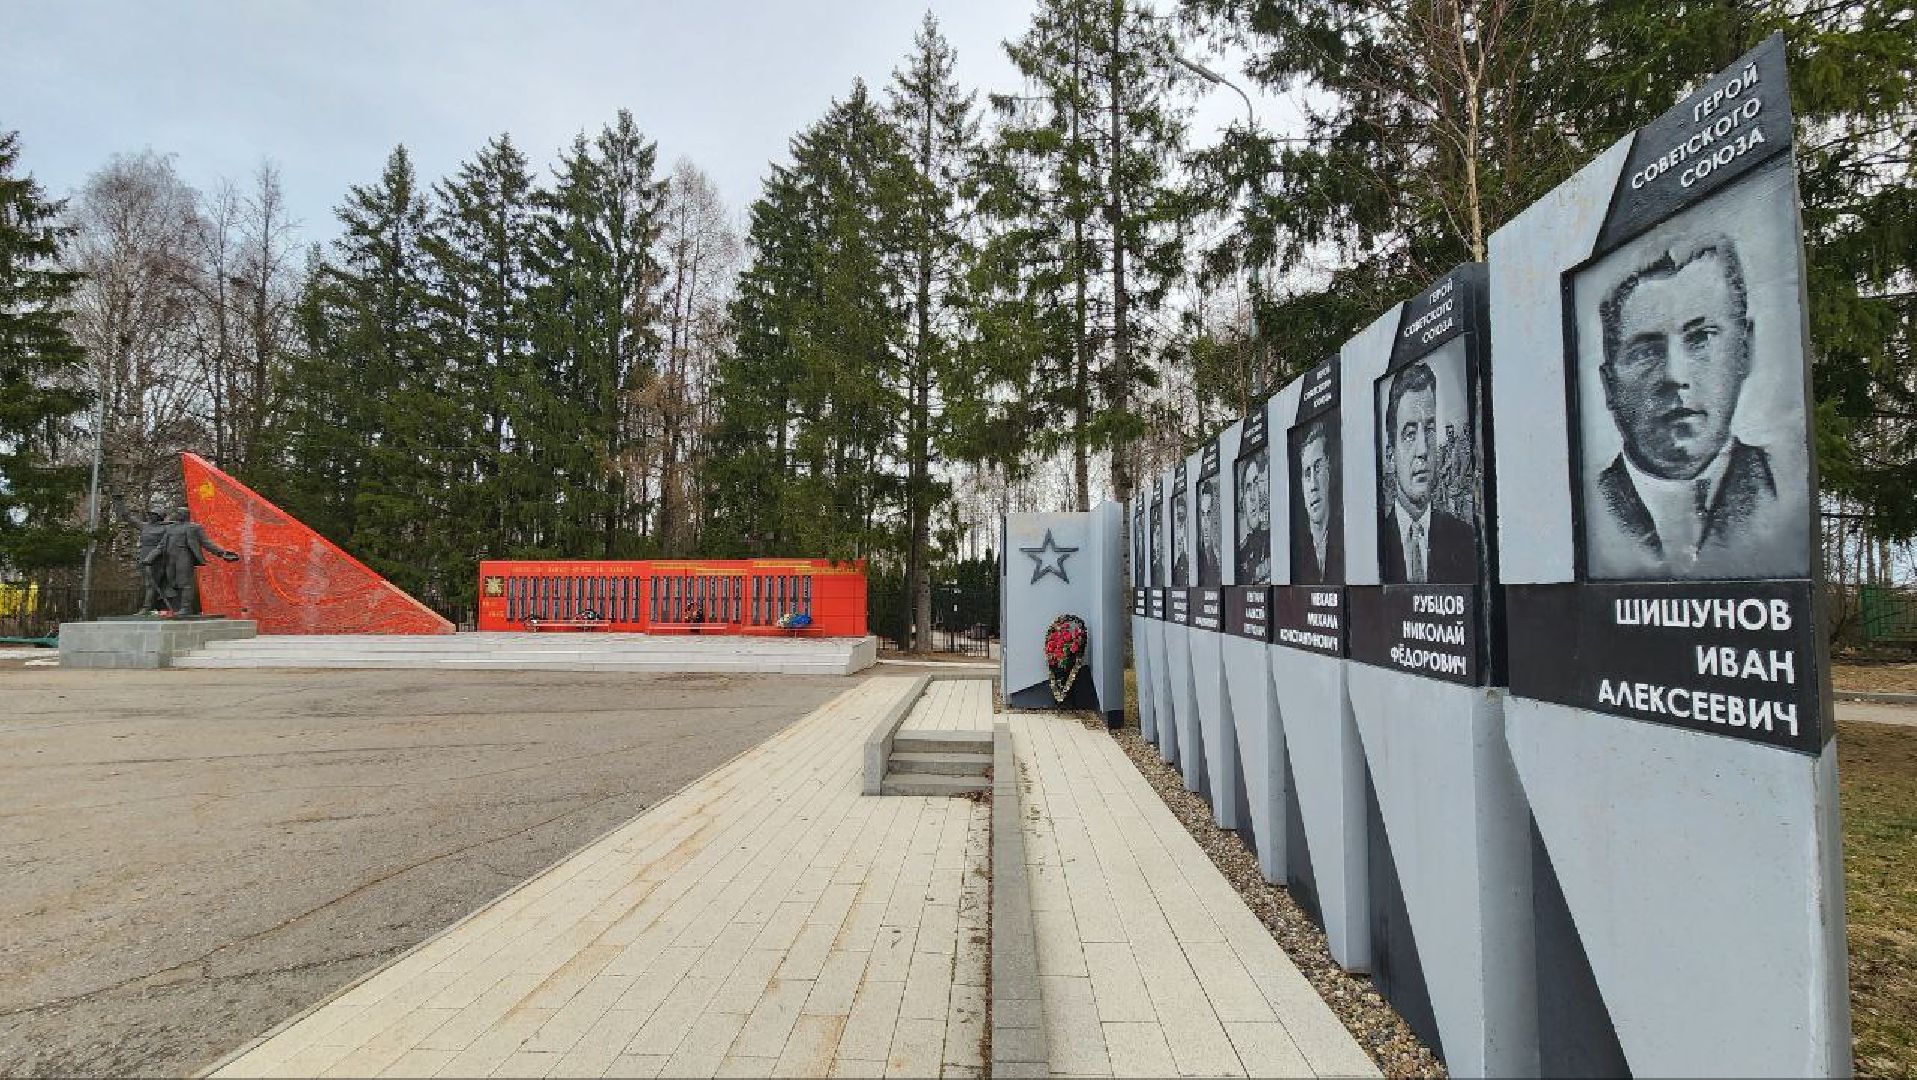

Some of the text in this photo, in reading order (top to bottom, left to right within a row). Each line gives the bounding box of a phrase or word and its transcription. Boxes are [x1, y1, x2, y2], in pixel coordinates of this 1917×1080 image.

[1694, 61, 1759, 122] ГЕРОЙ
[1631, 97, 1762, 189] СОВЕТСКОГО
[1680, 127, 1765, 188] СОЮЗА
[1429, 277, 1453, 305] ГЕРОЙ
[1403, 298, 1453, 338] СОВЕТСКОГО
[1421, 316, 1453, 344] СОЮЗА
[1412, 595, 1465, 616] РУБЦОВ
[1615, 598, 1792, 632] ШИШУНОВ
[1402, 620, 1465, 646] НИКОЛАЙ
[1390, 643, 1467, 676] ФЁДОРОВИЧ
[1695, 644, 1795, 684] ИВАН
[1598, 677, 1799, 737] АЛЕКСЕЕВИЧ
